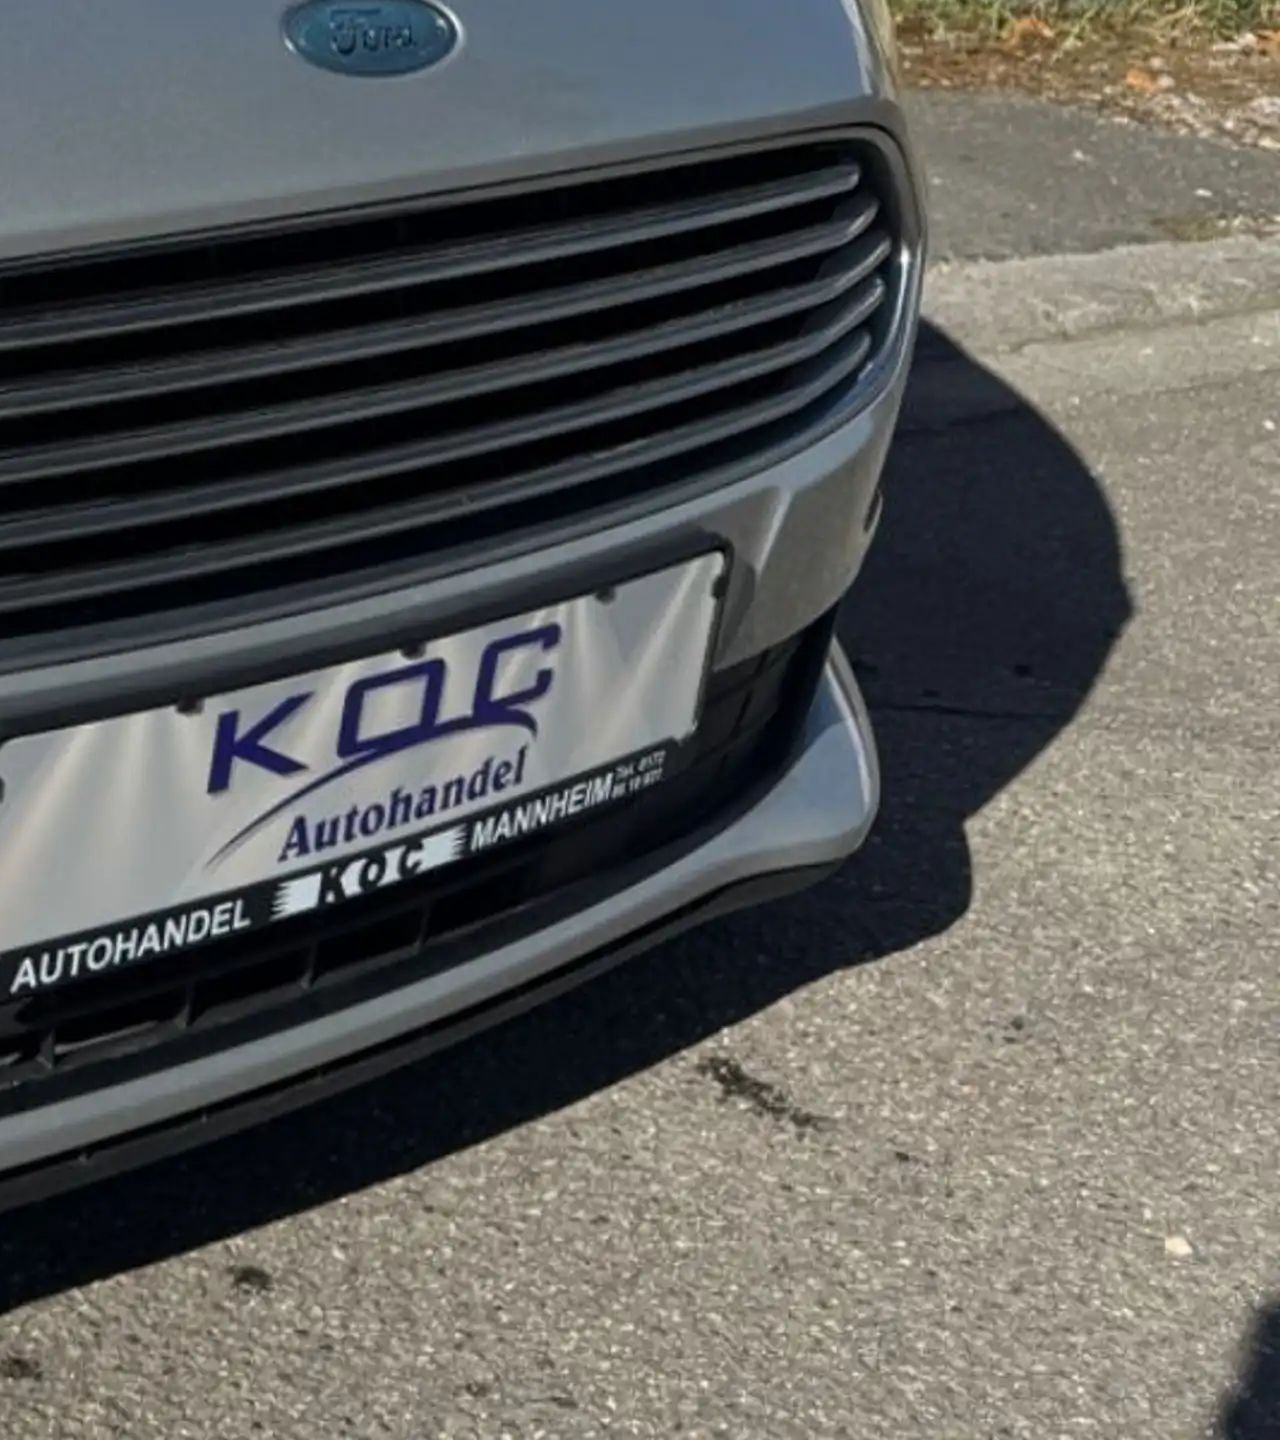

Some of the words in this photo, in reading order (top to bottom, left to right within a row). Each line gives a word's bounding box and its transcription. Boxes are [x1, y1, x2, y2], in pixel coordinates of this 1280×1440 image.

[10, 899, 251, 994] AUTOHANDEL
[470, 772, 615, 852] MANNHEIM
[277, 744, 527, 863] Autohandel
